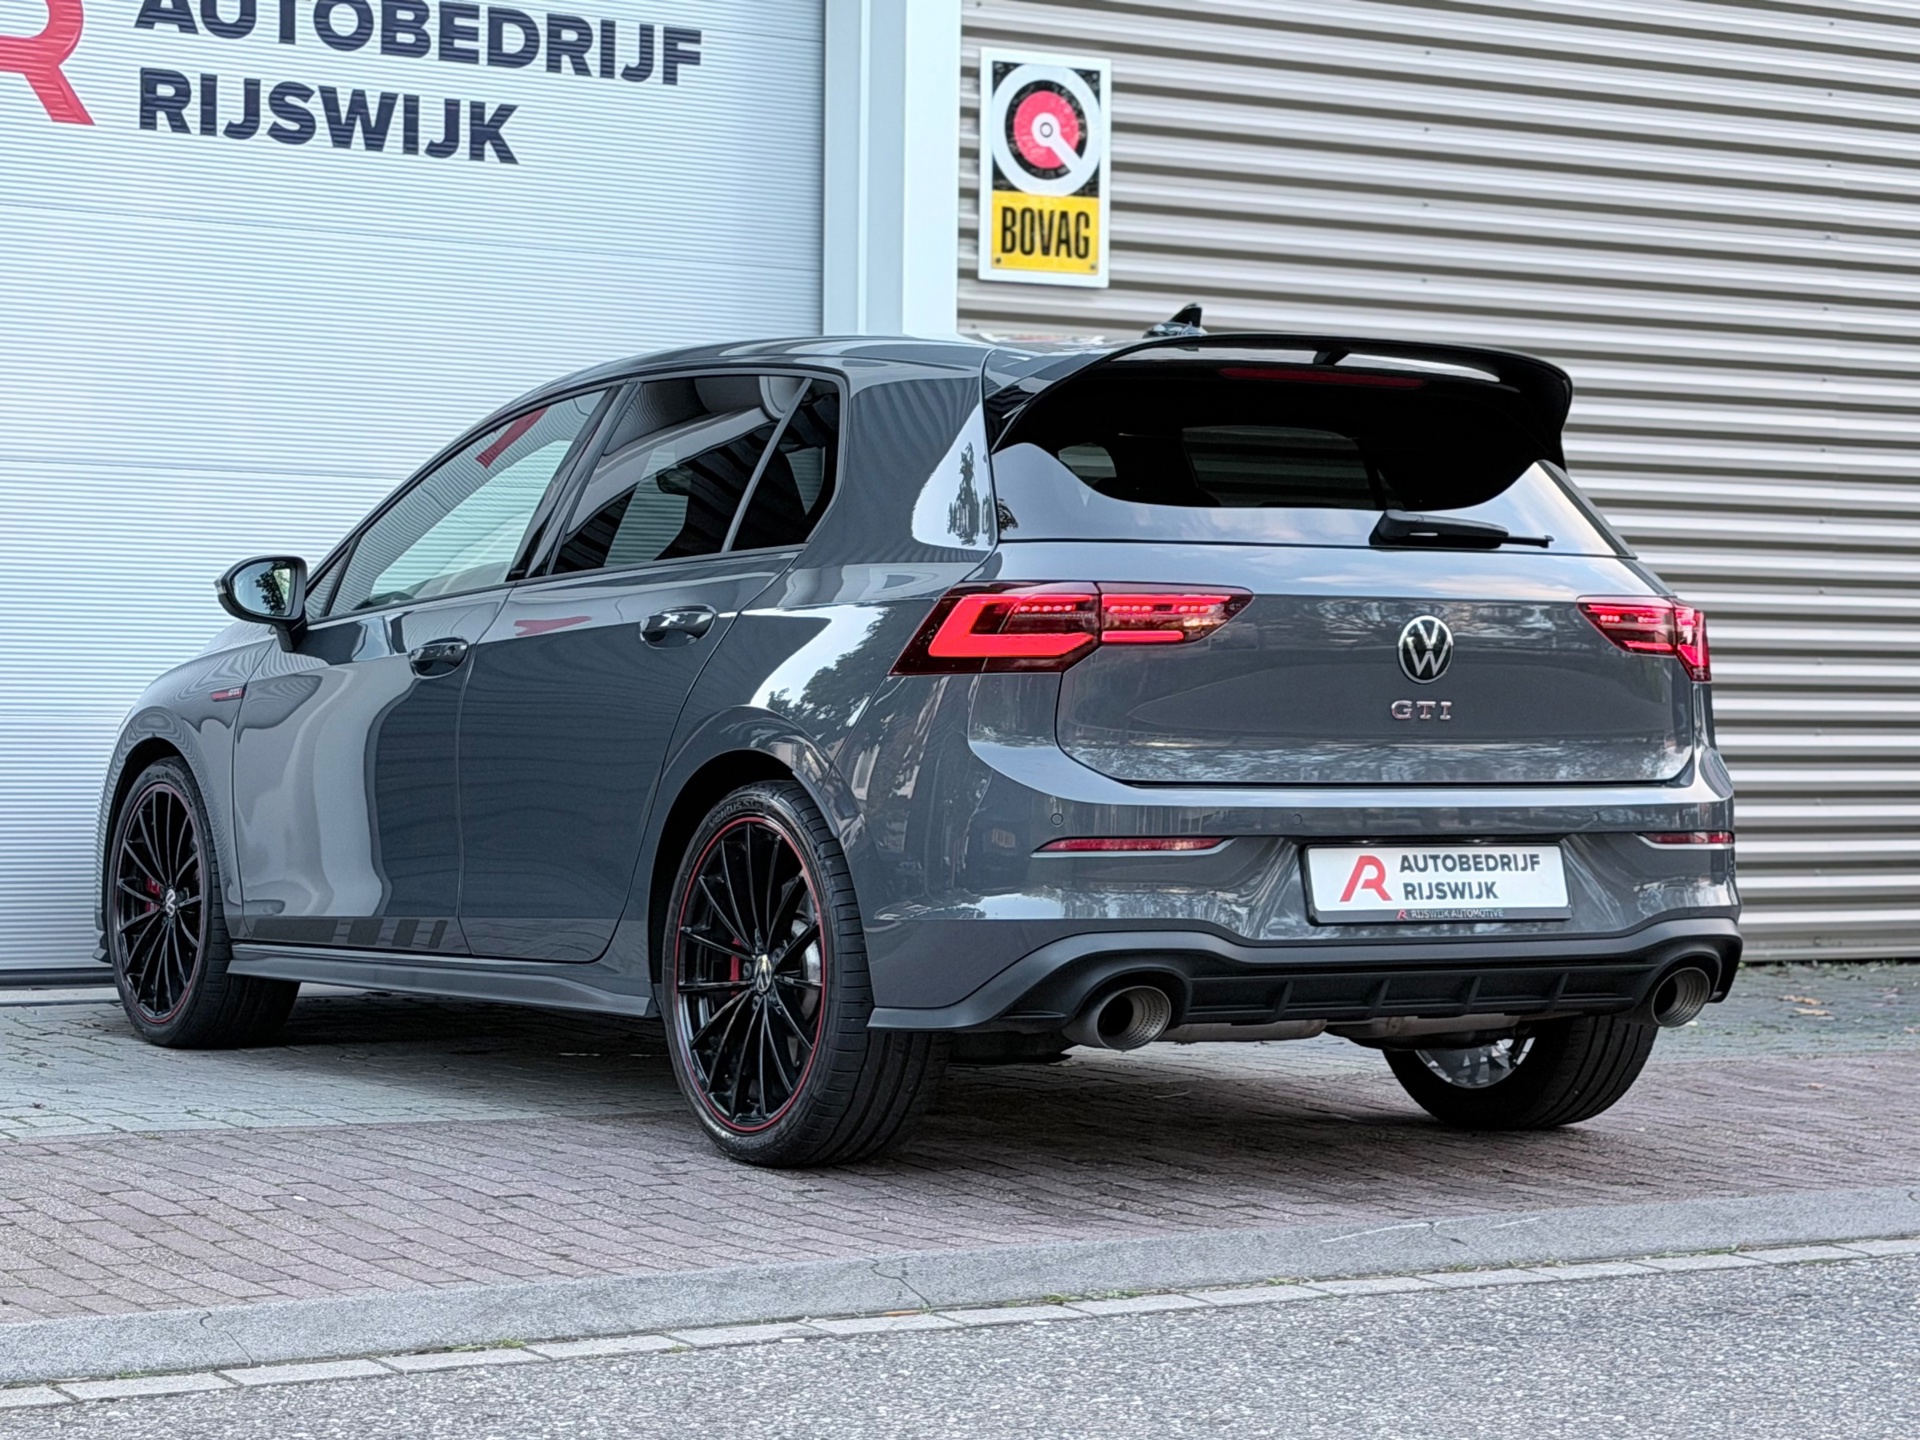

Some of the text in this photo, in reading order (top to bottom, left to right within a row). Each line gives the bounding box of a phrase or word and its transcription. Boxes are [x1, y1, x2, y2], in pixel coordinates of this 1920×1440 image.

[138, 67, 520, 165] RIJSWIJK
[1001, 206, 1090, 259] BOVAG
[1390, 699, 1453, 721] GTI
[1399, 853, 1540, 873] AUTOBEDRIJF
[1403, 882, 1499, 900] RIJSWIJK
[1411, 909, 1450, 919] RIJSWIJK
[1451, 908, 1504, 918] AUTOMOTIVE
